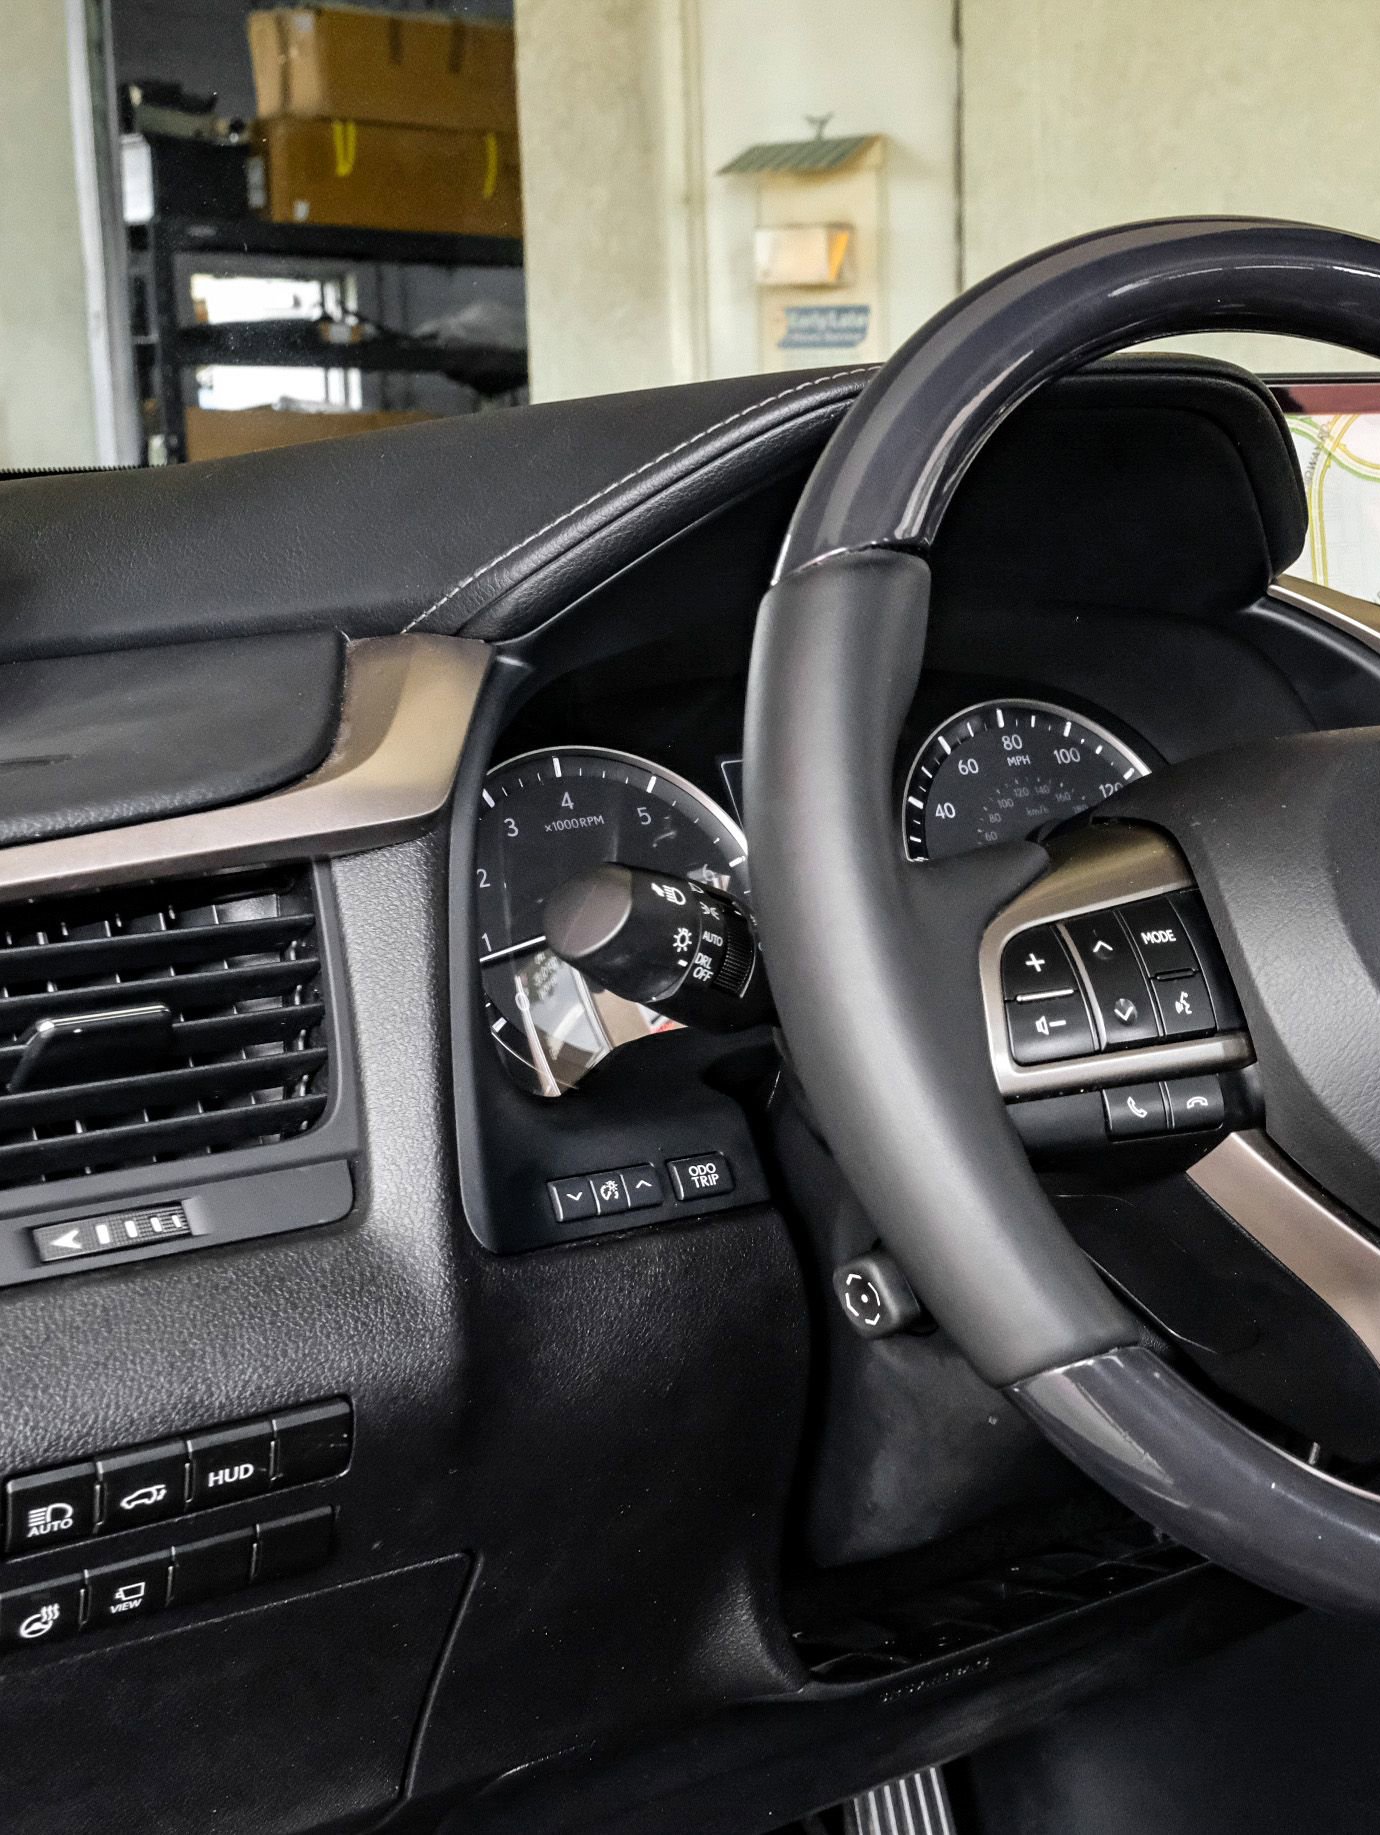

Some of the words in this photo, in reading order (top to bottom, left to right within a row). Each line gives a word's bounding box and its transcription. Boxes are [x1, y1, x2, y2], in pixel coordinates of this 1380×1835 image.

[1001, 734, 1023, 751] 80
[1007, 755, 1031, 767] MPH
[1053, 747, 1081, 764] 100
[957, 758, 979, 775] 60
[561, 791, 575, 810] 4
[1013, 787, 1030, 798] 120
[935, 802, 956, 820] 40
[997, 799, 1014, 809] 100
[637, 806, 652, 825] 5
[989, 813, 1001, 823] 80
[503, 818, 519, 837] 3
[476, 868, 491, 888] 2
[481, 932, 492, 952] 1
[702, 930, 723, 947] AUTO
[1141, 929, 1177, 945] MODE
[694, 952, 712, 970] DRL
[693, 966, 714, 982] OFF
[688, 1163, 717, 1177] ODO
[691, 1174, 719, 1188] TRIP
[208, 1463, 255, 1488] HUD
[27, 1518, 74, 1538] AUTO
[109, 1599, 143, 1614] VIEW
